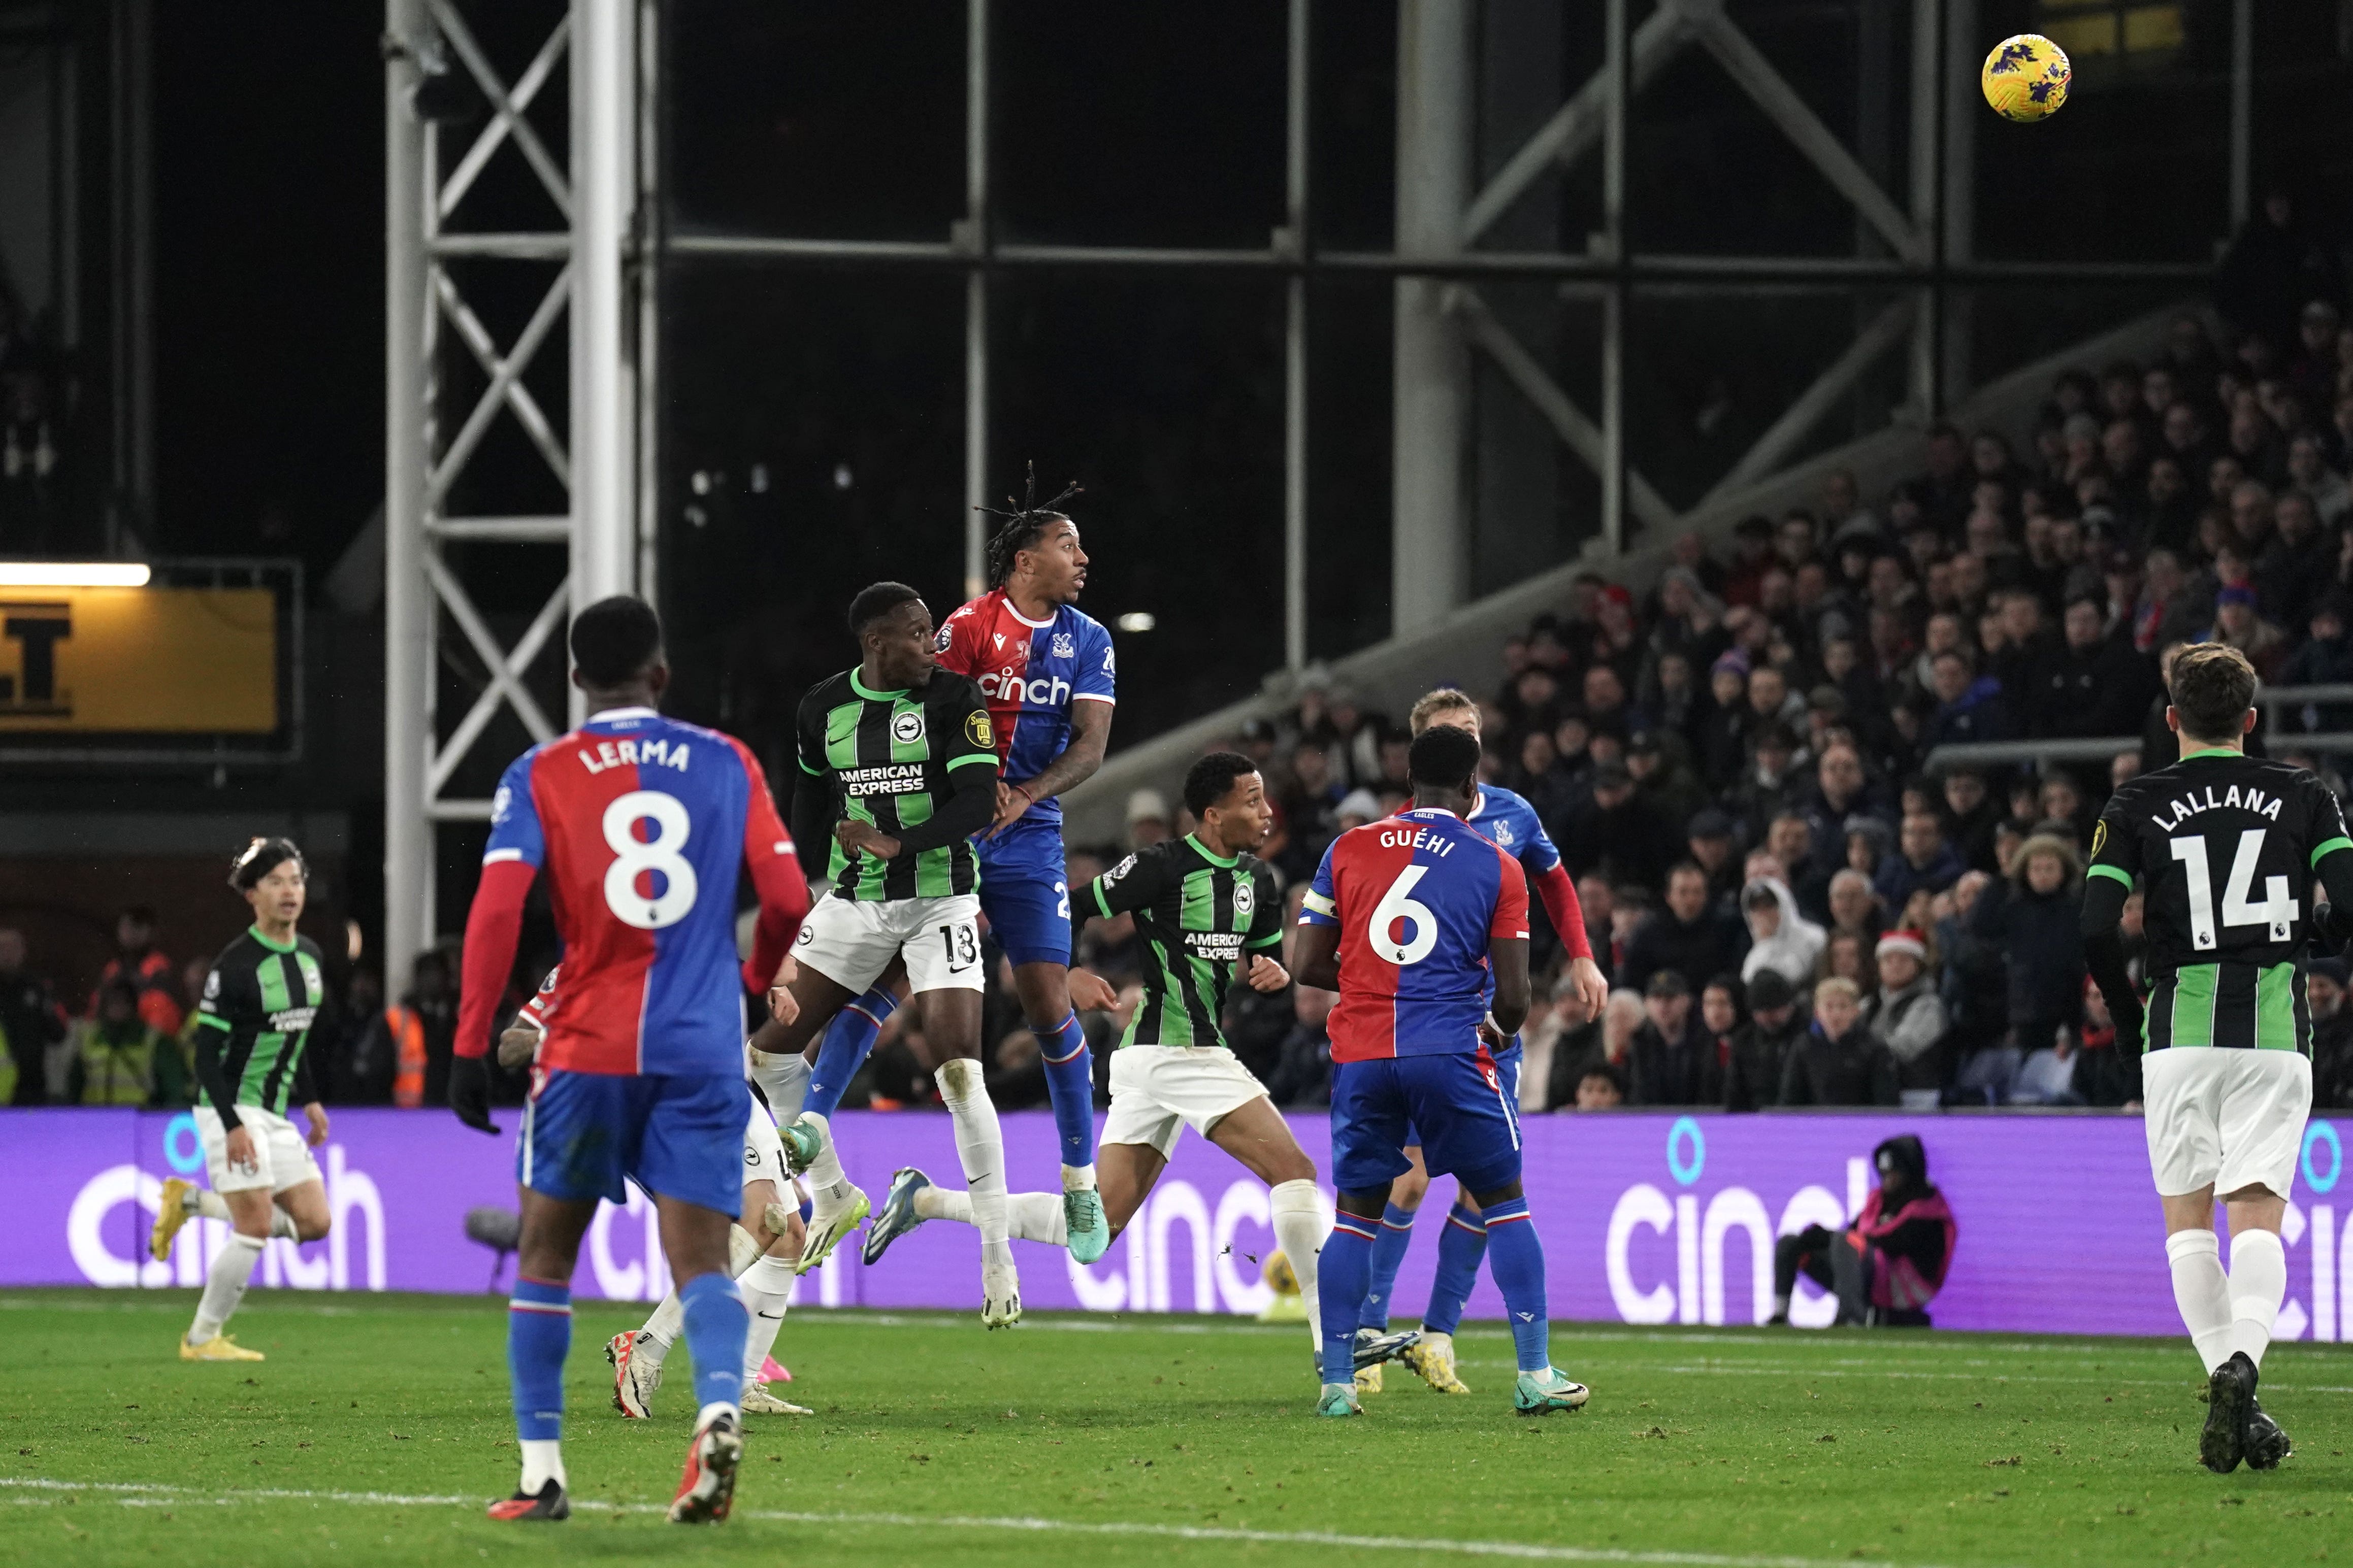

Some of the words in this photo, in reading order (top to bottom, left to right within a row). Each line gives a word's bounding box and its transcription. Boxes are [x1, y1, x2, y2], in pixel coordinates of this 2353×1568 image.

[977, 666, 1070, 706] cinch
[979, 725, 989, 738] UK
[578, 739, 691, 775] LERMA
[839, 764, 923, 783] AMERICAN
[848, 777, 925, 795] EXPRESS
[2151, 785, 2283, 832] LALLANA
[602, 790, 699, 930] 8
[1380, 827, 1456, 858] GUÉHI
[2170, 828, 2300, 951] 14
[1368, 864, 1438, 965] 6
[1184, 933, 1246, 947] AMERICAN
